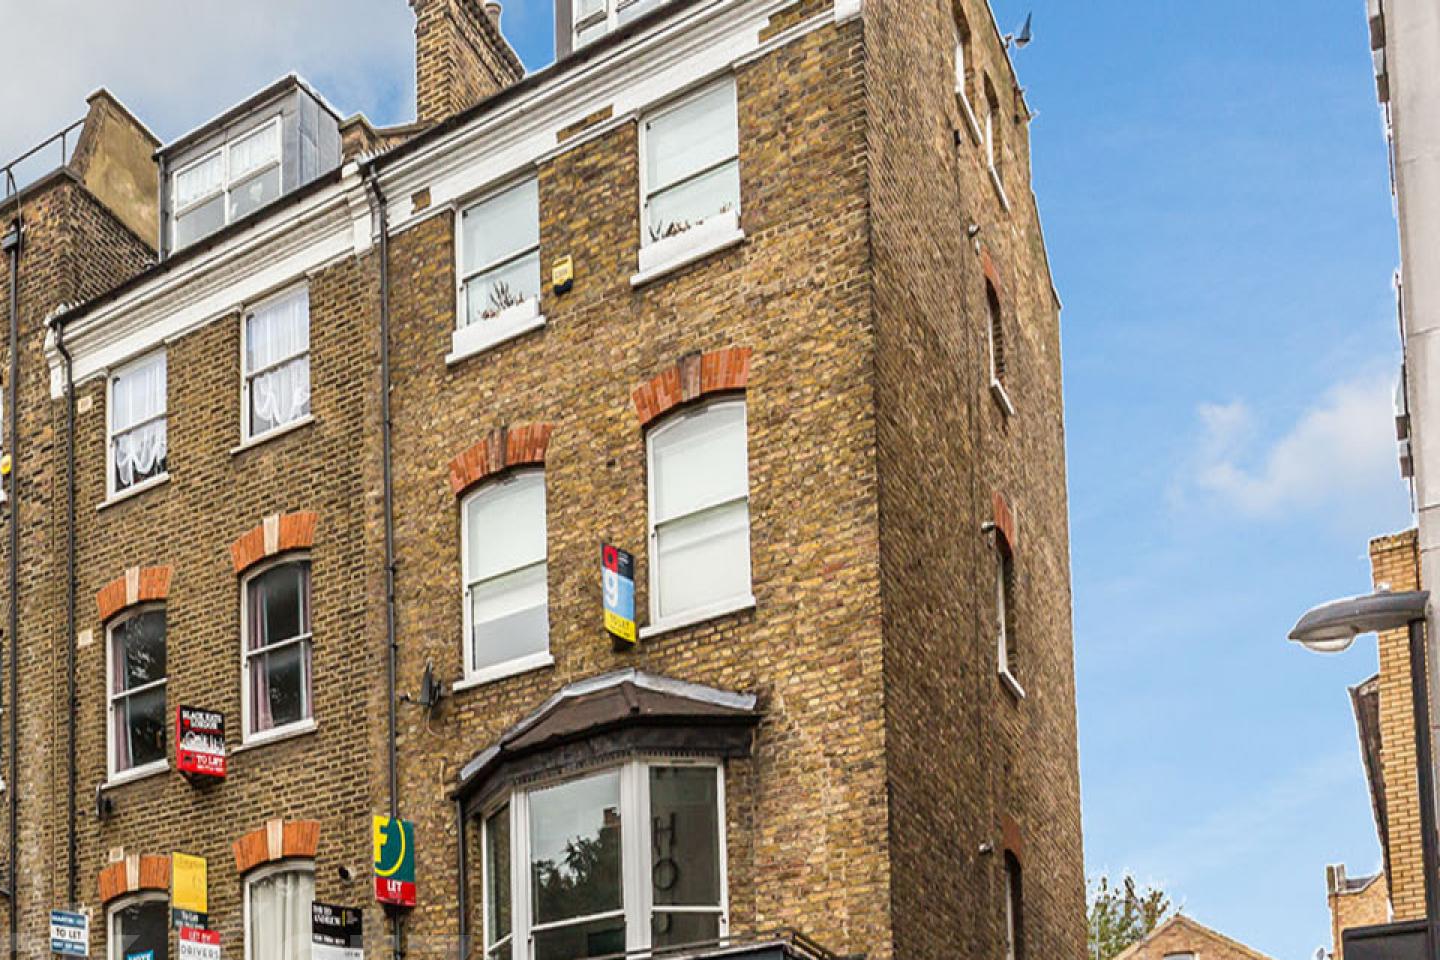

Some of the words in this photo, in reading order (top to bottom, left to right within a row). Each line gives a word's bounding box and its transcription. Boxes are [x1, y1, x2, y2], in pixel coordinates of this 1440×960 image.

[387, 879, 402, 892] LET
[56, 928, 66, 937] TO
[68, 930, 81, 939] LET
